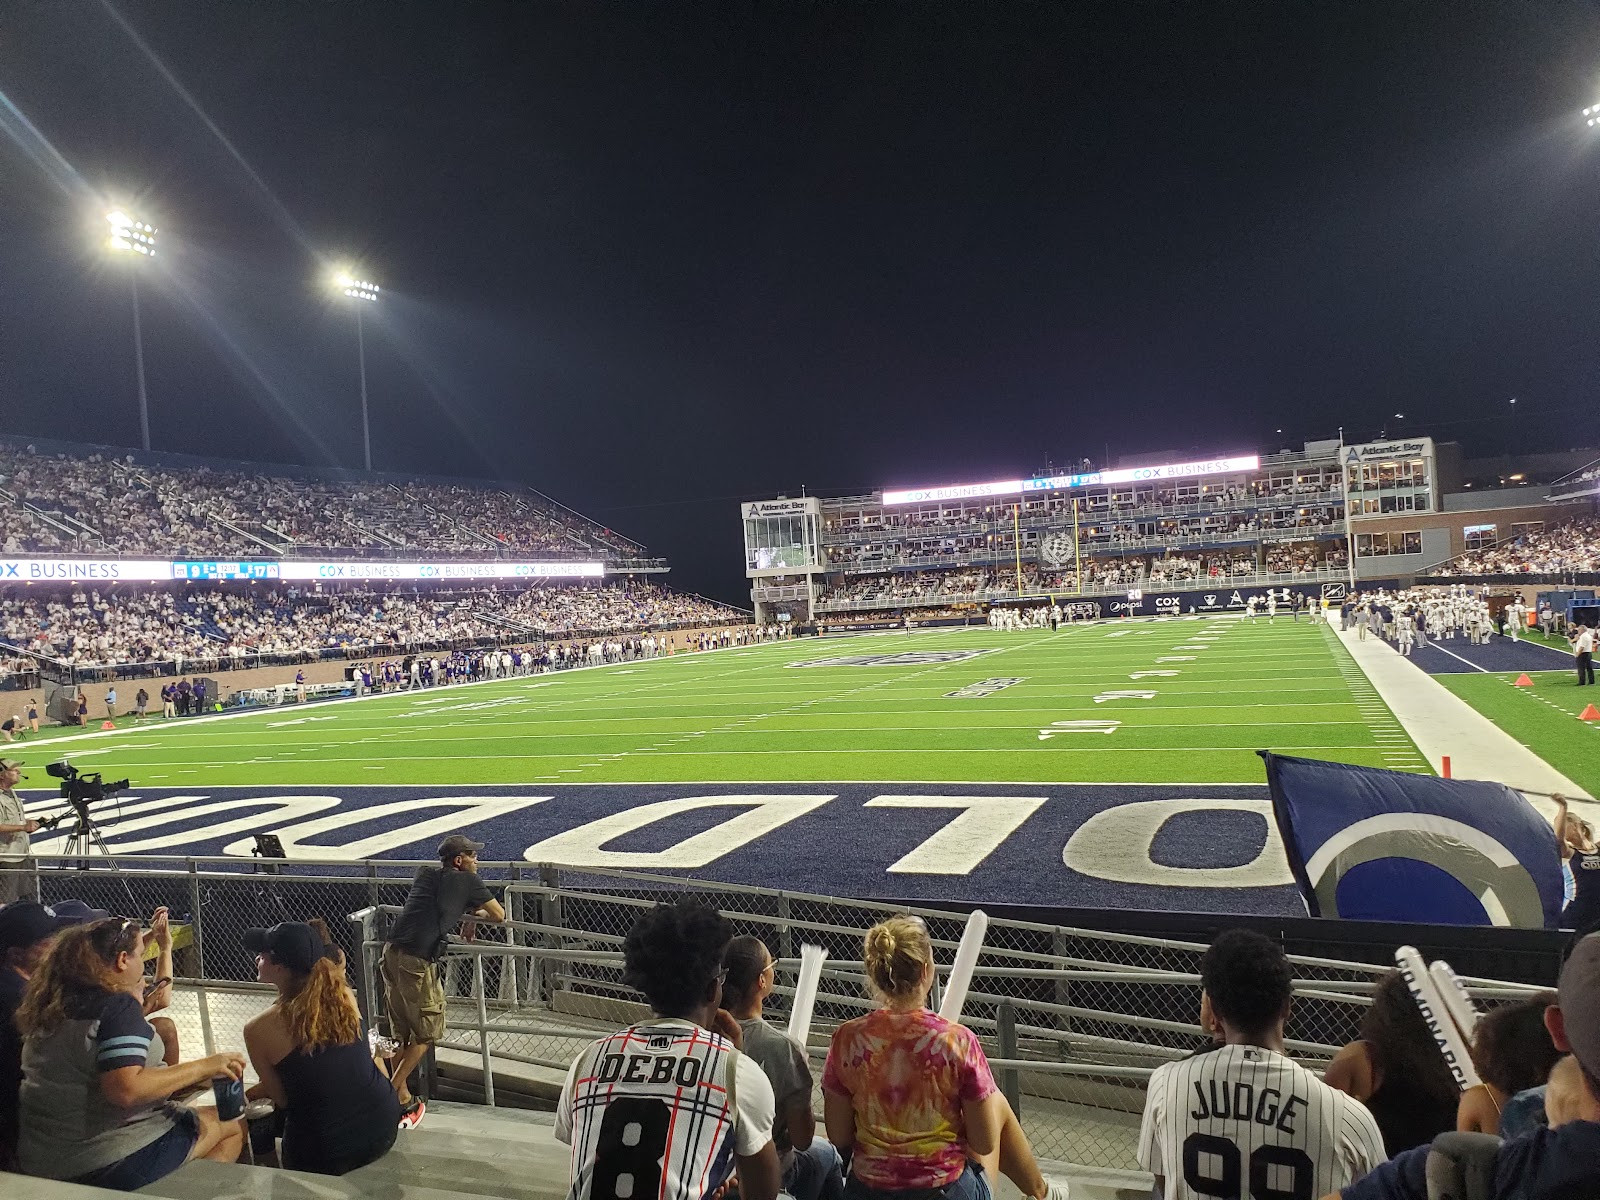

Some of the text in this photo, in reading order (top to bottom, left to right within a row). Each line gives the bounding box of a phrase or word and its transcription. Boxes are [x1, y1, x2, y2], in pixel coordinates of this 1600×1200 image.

[1361, 443, 1424, 455] Atlantic Bay
[1134, 461, 1230, 479] COX BUSINESS
[906, 485, 992, 501] COX BUSINESS
[760, 502, 790, 511] Atlantic
[30, 563, 119, 578] BUSINESS
[253, 565, 267, 578] 17
[319, 565, 400, 577] COX BUSINESS
[420, 565, 496, 577] COX BUSINESS
[515, 565, 583, 575] COX BUSINESS
[1128, 589, 1142, 600] 20
[1155, 597, 1180, 606] COX
[597, 1053, 702, 1088] DEBO
[1191, 1079, 1309, 1135] JUDGE
[590, 1096, 672, 1200] 8
[1183, 1132, 1314, 1200] 99
